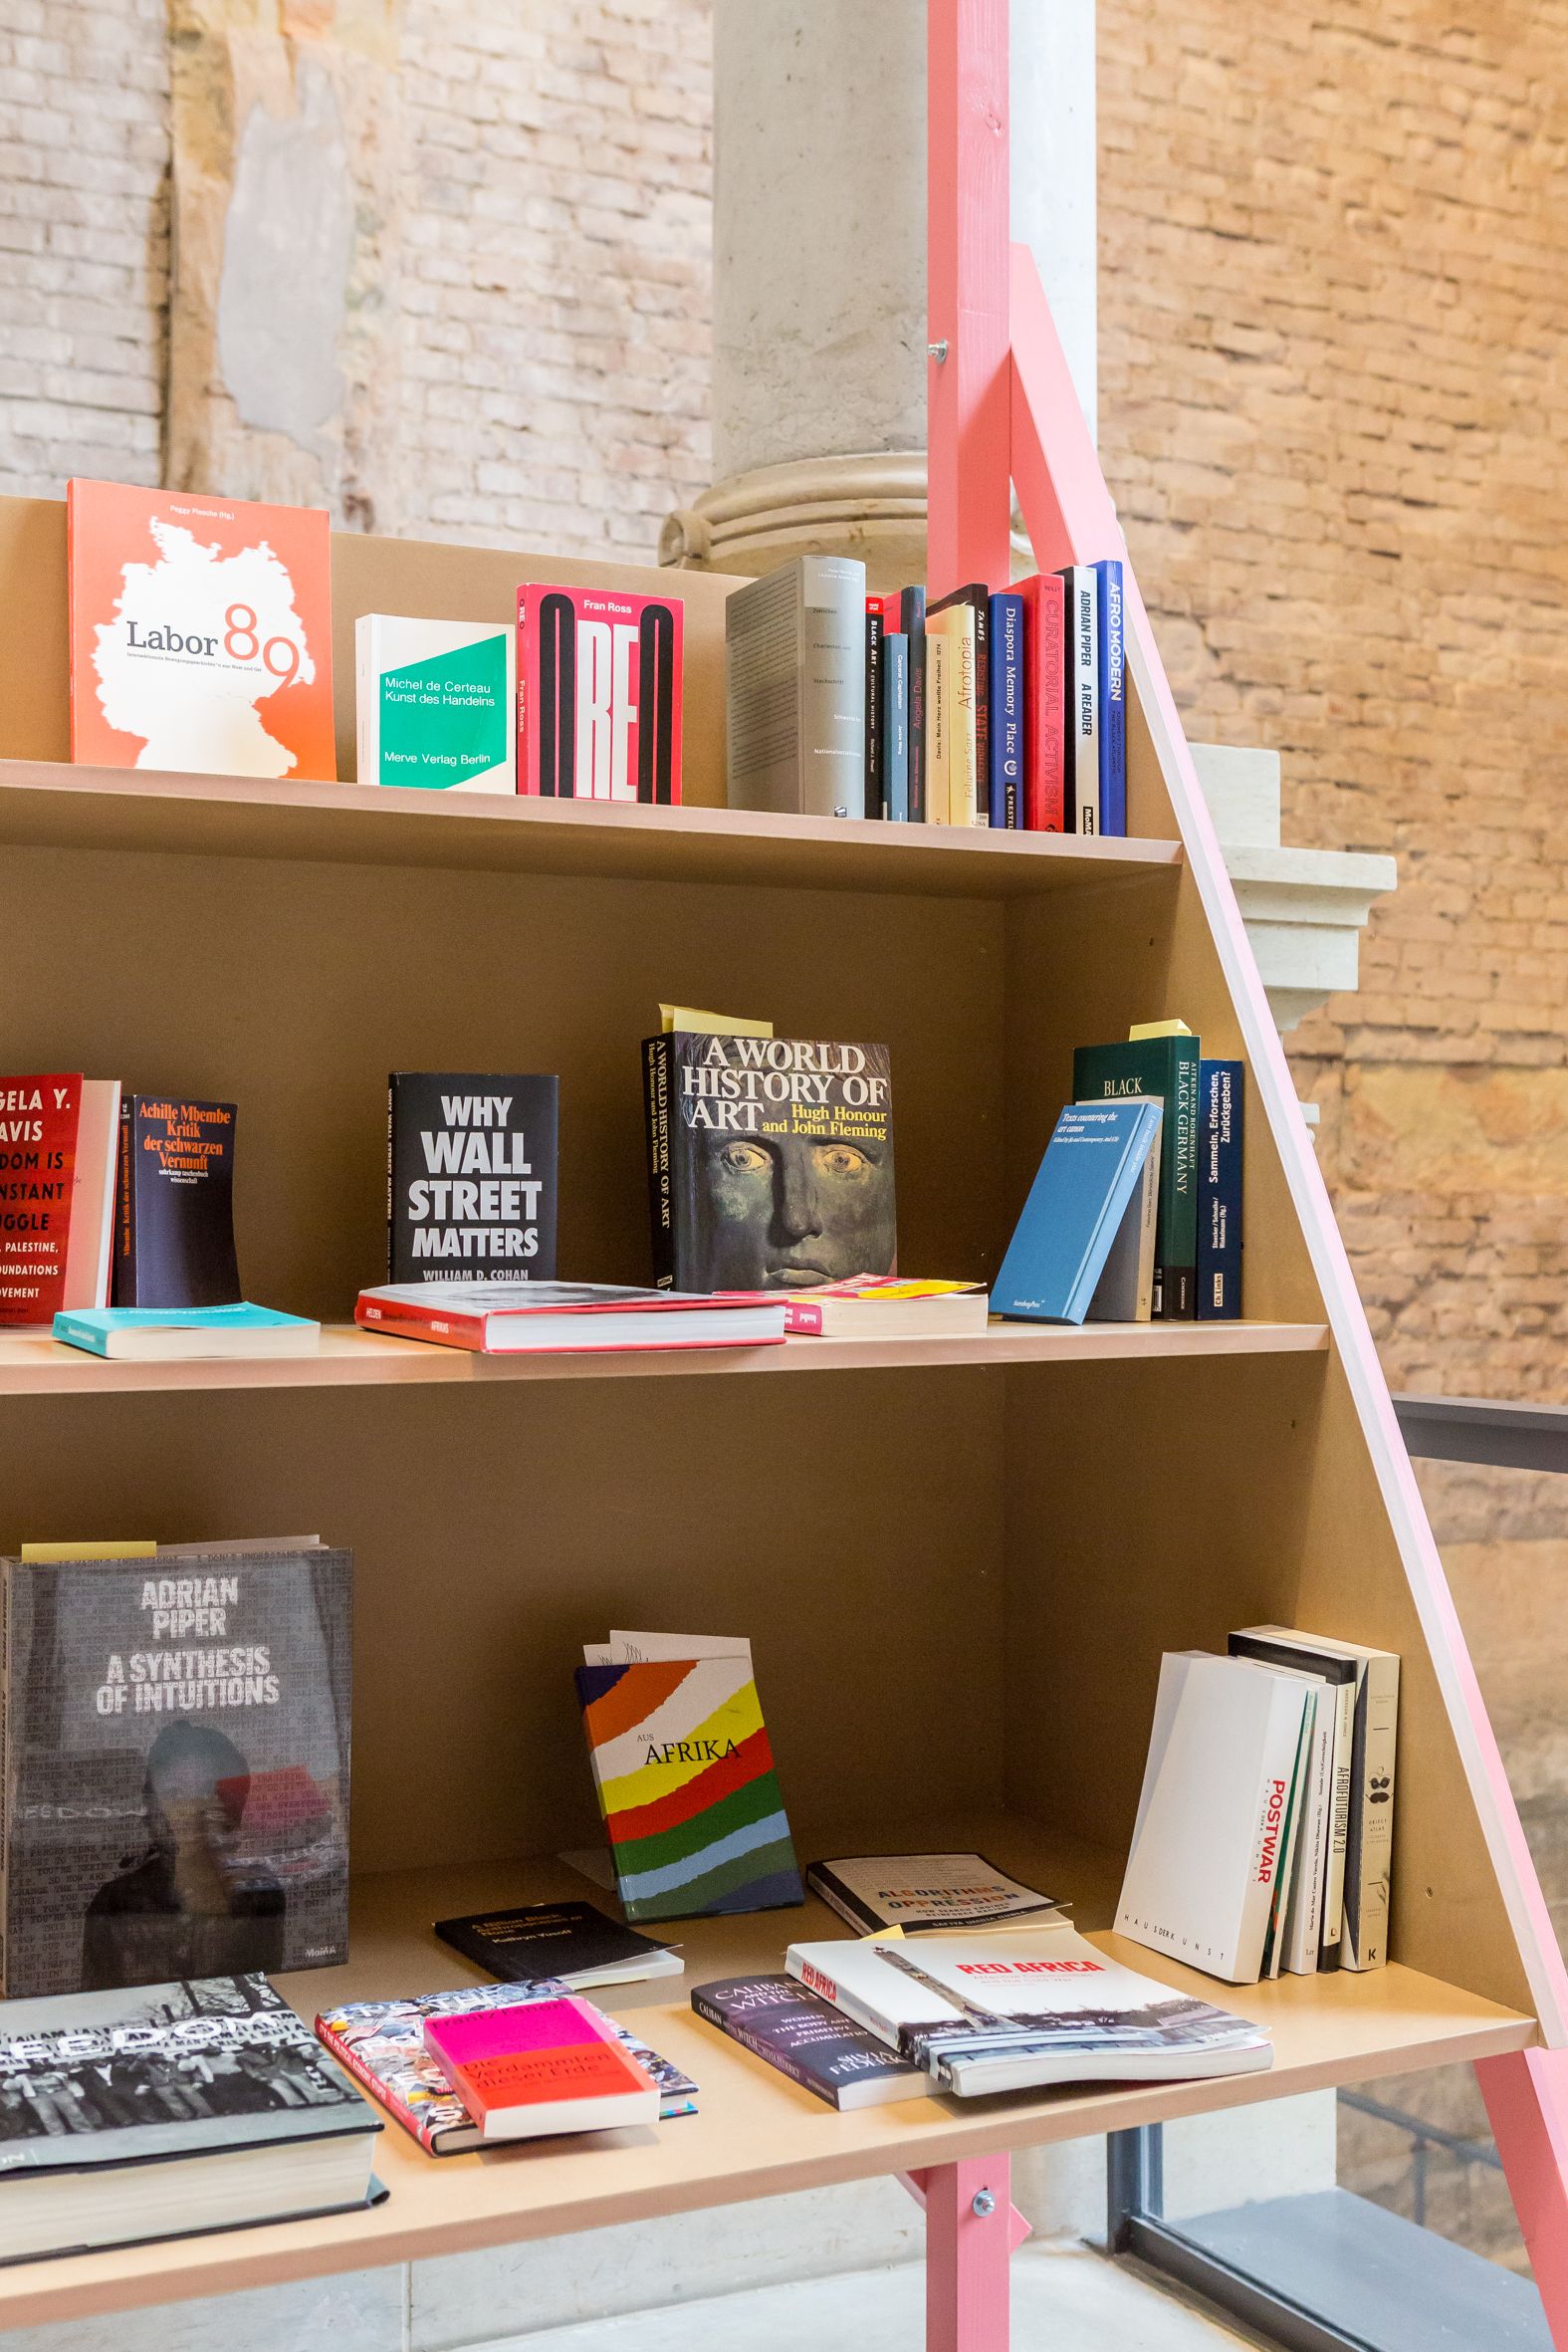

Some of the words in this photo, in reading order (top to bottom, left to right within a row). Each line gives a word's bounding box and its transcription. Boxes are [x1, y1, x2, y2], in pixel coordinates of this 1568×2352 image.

[583, 599, 605, 611] Fran
[607, 601, 632, 613] Ross
[1080, 590, 1091, 632] ADRIAN
[1109, 582, 1121, 627] AFRO
[1005, 607, 1016, 661] Diaspora
[127, 621, 218, 656] Labor
[224, 603, 300, 696] 89
[1045, 599, 1059, 717] CURATORIAL
[1081, 635, 1091, 667] PIPER
[958, 637, 974, 709] Afrotopia
[1110, 630, 1121, 701] MODERN
[385, 677, 422, 691] Michel
[426, 680, 440, 691] de
[444, 681, 490, 693] Certeau
[385, 691, 416, 703] Kunst
[419, 693, 440, 705] des
[442, 694, 495, 707] Handelns
[1005, 667, 1016, 716] Memory
[914, 696, 923, 729] Angela
[976, 704, 988, 740] STATE
[1082, 693, 1092, 735] READER
[1007, 723, 1016, 754] Place
[384, 751, 418, 763] Merve
[422, 753, 457, 766] Verlag
[460, 753, 490, 765] Berlin
[1045, 725, 1059, 815] ACTIVISM
[964, 760, 973, 799] Felwine
[647, 1044, 656, 1065] Hugh
[656, 1041, 666, 1053] A
[703, 1038, 729, 1065] A
[734, 1039, 865, 1073] WORLD
[657, 1053, 668, 1107] WORLD
[683, 1066, 833, 1104] HISTORY
[842, 1077, 887, 1106] OF
[1104, 1077, 1143, 1096] BLACK
[1178, 1061, 1190, 1111] BLACK
[53, 1088, 70, 1109] Y.
[139, 1101, 178, 1119] Achille
[180, 1105, 231, 1124] Mbembe
[441, 1095, 513, 1127] WHY
[791, 1103, 830, 1123] Hugh
[834, 1108, 887, 1123] Honour
[1209, 1071, 1220, 1128] Erforschen,
[1220, 1071, 1231, 1143] Zurückgeben?
[167, 1120, 201, 1137] Kritik
[689, 1099, 765, 1131] ART
[763, 1119, 788, 1133] and
[791, 1120, 825, 1135] John
[830, 1123, 887, 1140] Fleming
[0, 1120, 43, 1142] AVIS
[143, 1134, 163, 1151] der
[165, 1137, 223, 1155] schwarzen
[658, 1109, 669, 1171] HISTORY
[48, 1151, 64, 1170] IS
[159, 1151, 208, 1170] Vernunft
[420, 1131, 532, 1174] WALL
[1176, 1114, 1189, 1195] GERMANY
[1209, 1131, 1220, 1183] Sammeln,
[661, 1176, 669, 1194] OF
[408, 1180, 542, 1221] STREET
[661, 1198, 670, 1229] ART
[5, 1243, 58, 1254] PALESTINE,
[412, 1228, 539, 1257] MATTERS
[423, 1270, 472, 1282] WILLIAM
[476, 1270, 488, 1281] D.
[491, 1269, 529, 1281] COHAN
[366, 1307, 380, 1319] HELDEN
[140, 1577, 239, 1610] ADRIAN
[152, 1607, 227, 1639] PIPER
[107, 1655, 125, 1684] A
[129, 1646, 271, 1683] SYNTHESIS
[97, 1685, 128, 1715] OF
[135, 1675, 280, 1713] INTUITIONS
[645, 1739, 741, 1764] AFRIKA
[1334, 1766, 1349, 1837] AFROFUTURISM
[1257, 1779, 1285, 1883] POSTWAR
[1333, 1840, 1346, 1853] 2.0
[878, 1886, 1006, 1899] ALGORITHMS
[888, 1893, 1019, 1909] OPPRESSION
[492, 1933, 538, 1944] Kathryn
[1159, 1928, 1170, 1938] DER
[305, 1946, 336, 1957] MoMA
[1368, 1948, 1376, 1961] K
[800, 1960, 814, 1984] RED
[814, 1973, 837, 2002] AFRICA
[956, 1964, 1013, 1975] RED
[1011, 1961, 1107, 1973] AFRICA
[715, 1981, 803, 2000] CALIBAN
[731, 1992, 820, 2010] WITCH
[432, 2011, 496, 2029] Frantz
[500, 2001, 566, 2015] Fanon
[699, 2001, 722, 2024] CALIBAN
[737, 2027, 758, 2050] WITCH
[772, 2025, 796, 2034] THE
[798, 2020, 828, 2029] BODY
[319, 2023, 328, 2035] IT'S
[334, 2041, 352, 2066] POLITICAL
[352, 2058, 371, 2085] ECONOMY
[463, 2059, 498, 2071] Die
[468, 2054, 610, 2079] Verdammten
[837, 2051, 894, 2063] SILVIA
[477, 2071, 542, 2088] dieser
[550, 2065, 599, 2076] Erde
